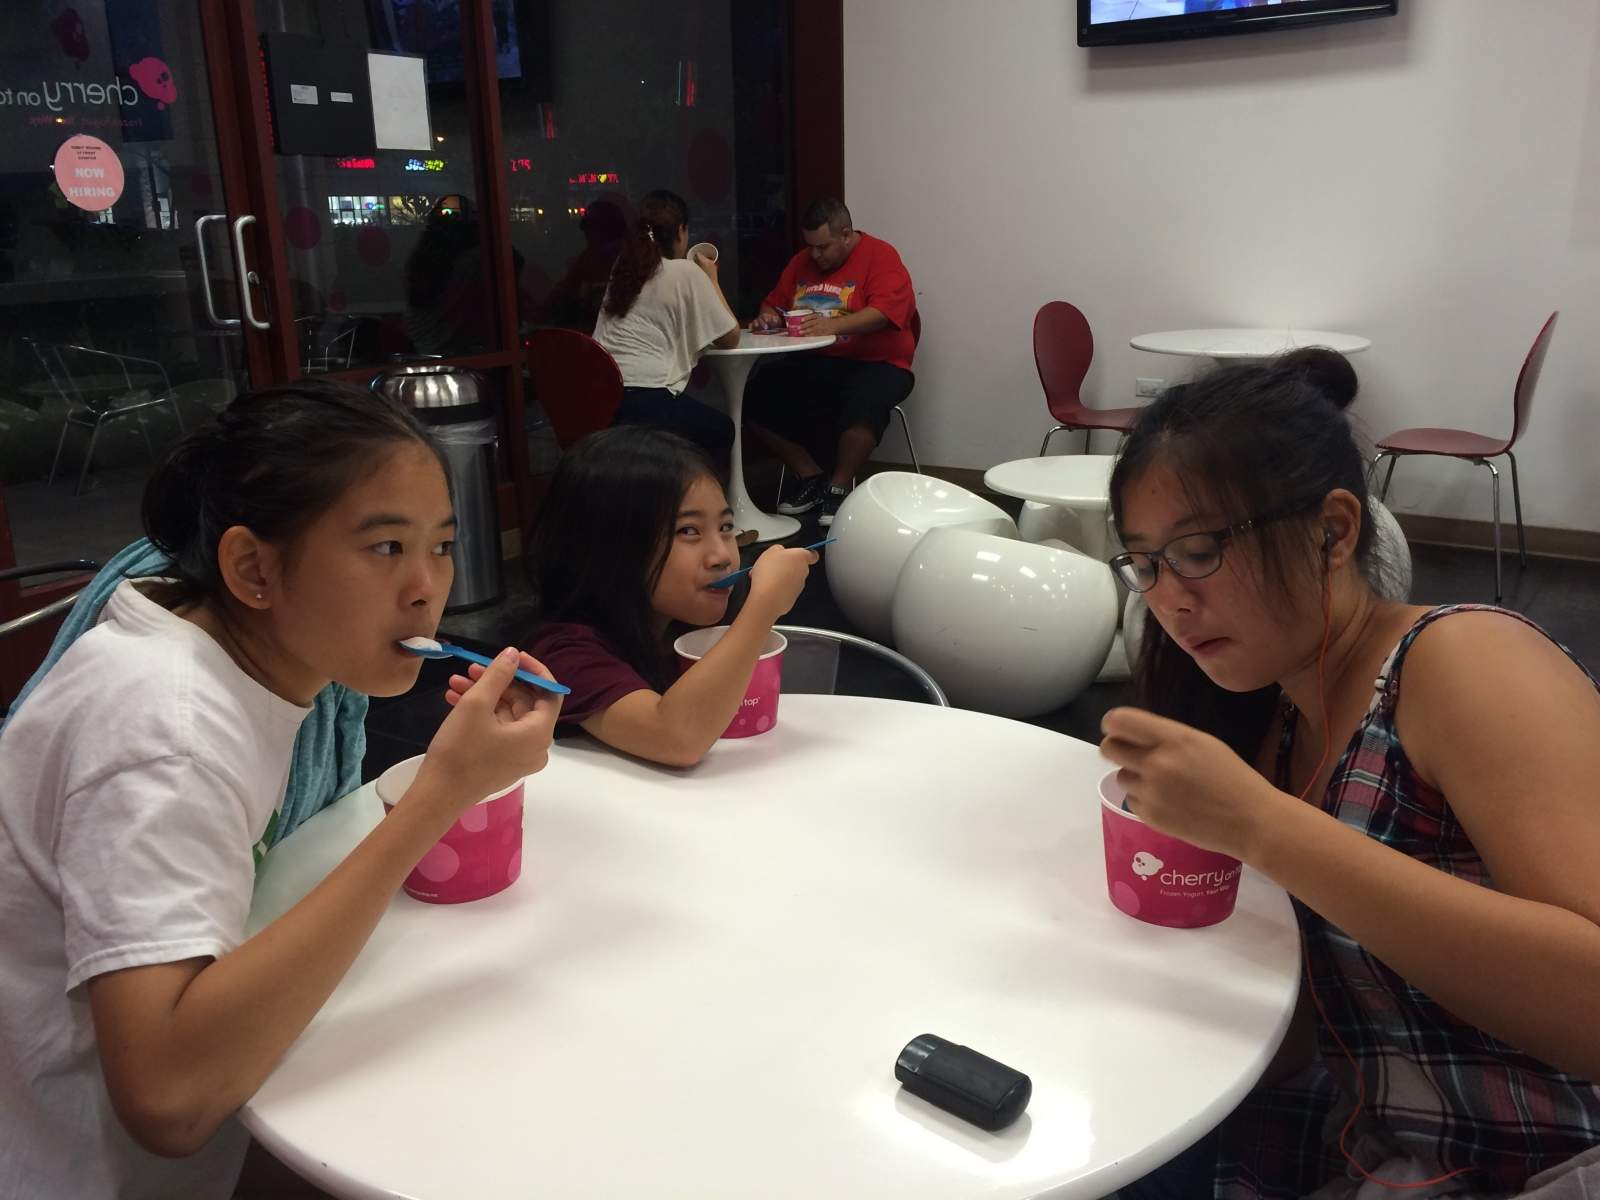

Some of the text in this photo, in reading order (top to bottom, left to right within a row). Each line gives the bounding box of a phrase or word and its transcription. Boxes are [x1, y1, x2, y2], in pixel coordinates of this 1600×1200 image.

[75, 168, 104, 178] NOW
[68, 187, 114, 198] HIRING
[743, 698, 759, 707] top
[1160, 869, 1224, 887] cherry
